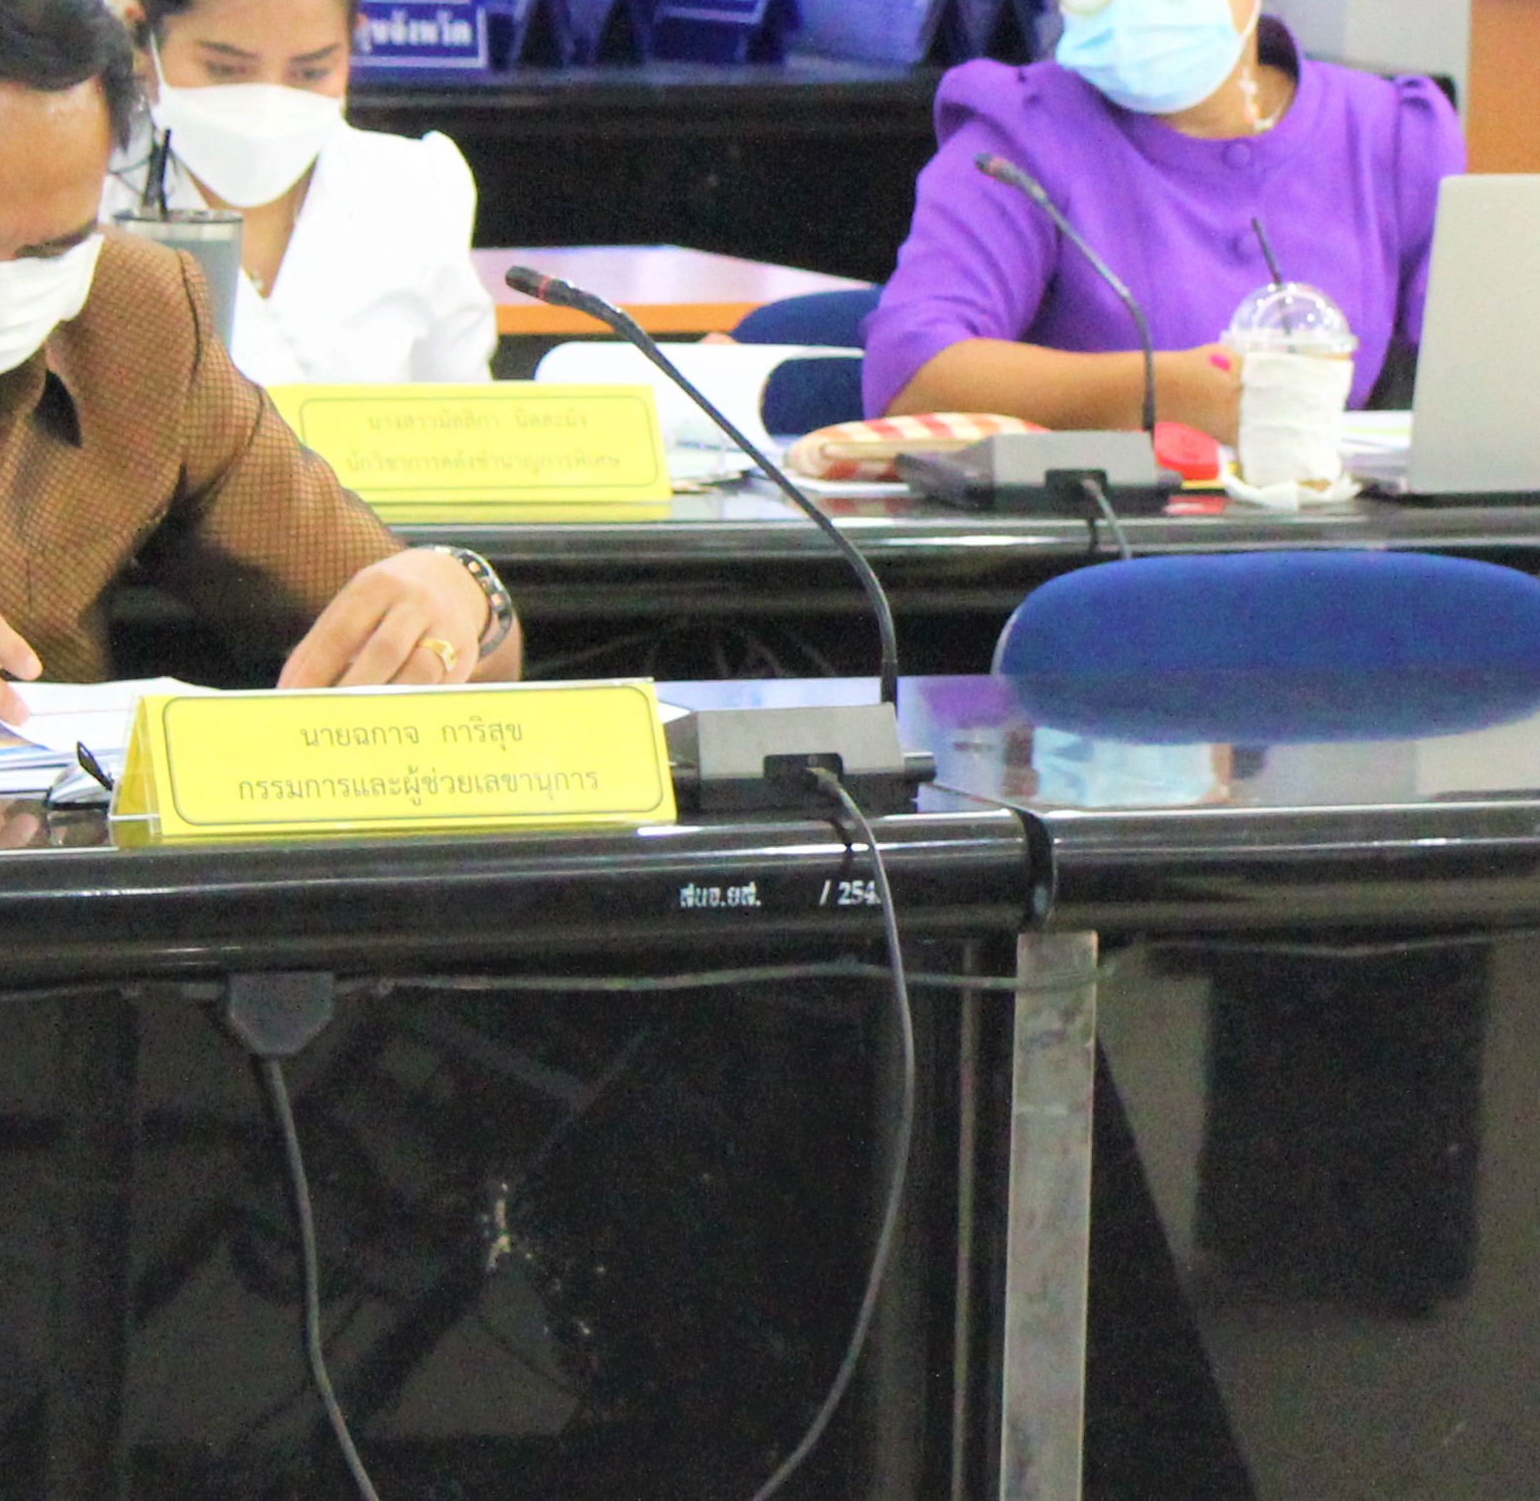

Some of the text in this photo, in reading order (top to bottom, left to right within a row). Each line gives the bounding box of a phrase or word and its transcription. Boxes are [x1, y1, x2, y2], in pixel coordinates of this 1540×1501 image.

[299, 715, 524, 753] นายฉกาจ การิสุข
[237, 765, 600, 806] กรรมการและผู้ช่วยเลขานุการ
